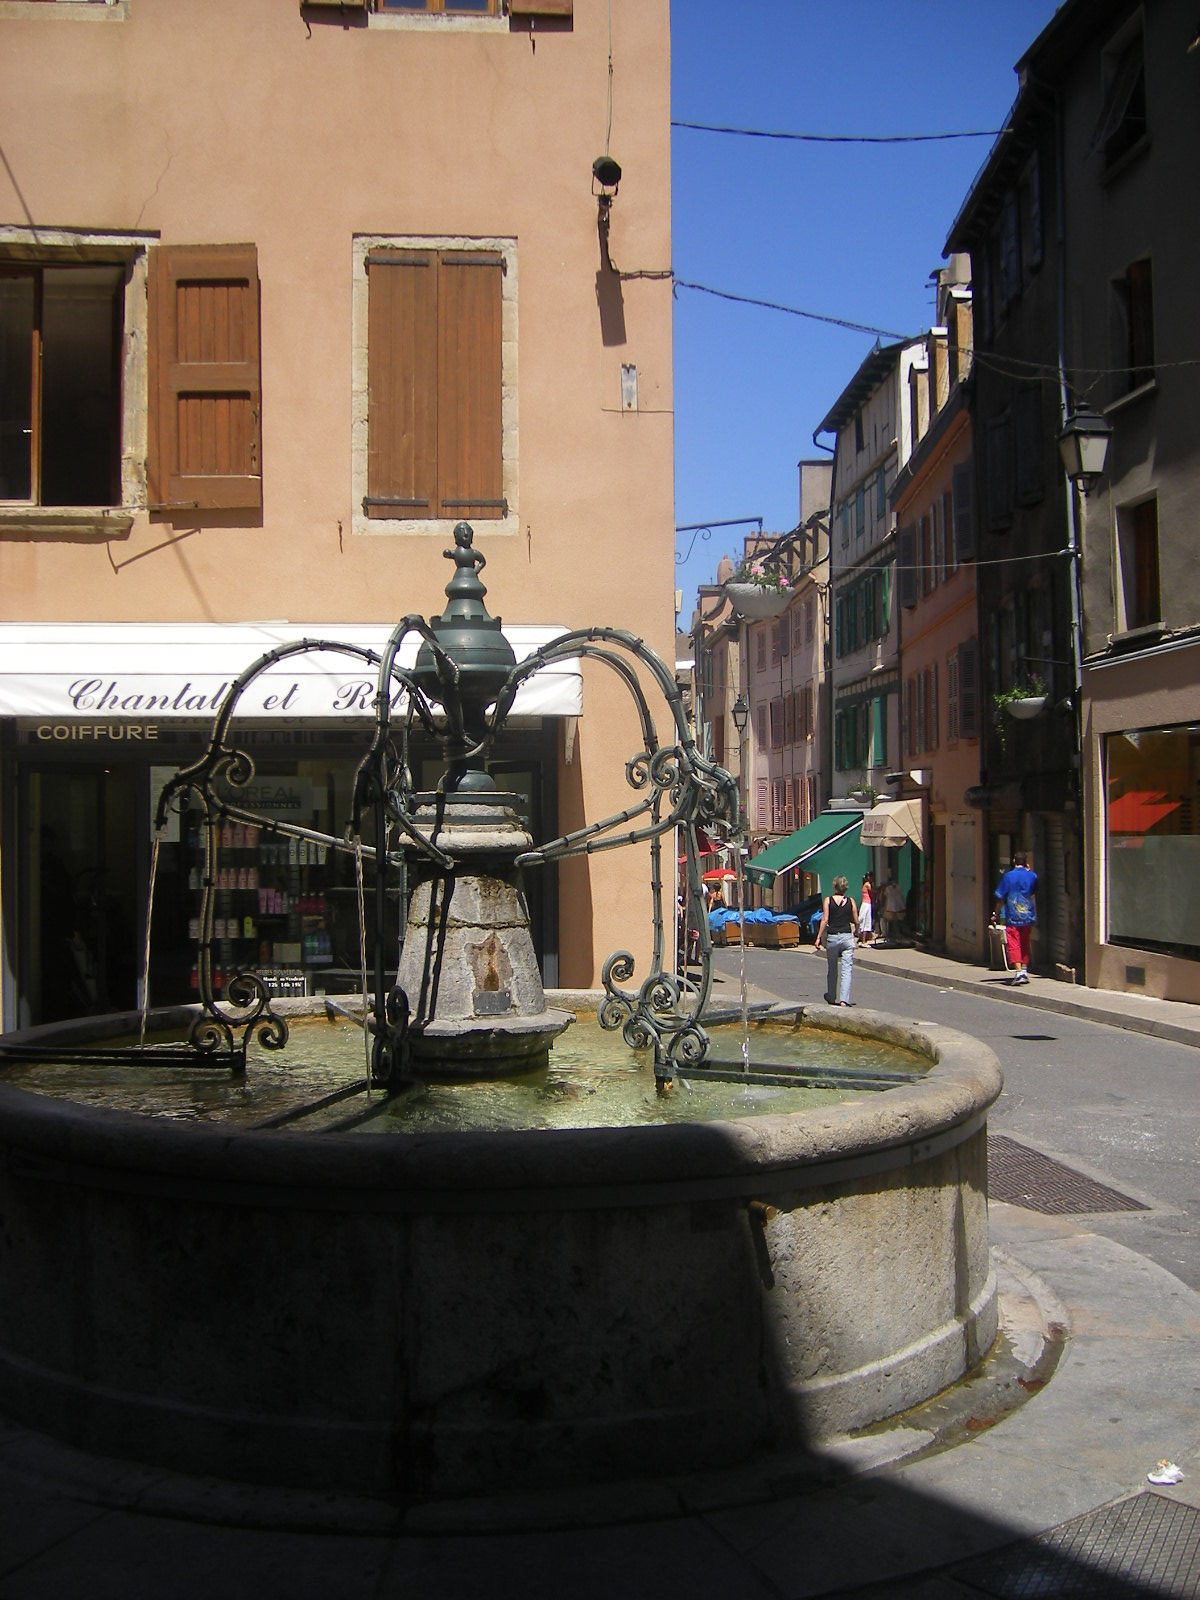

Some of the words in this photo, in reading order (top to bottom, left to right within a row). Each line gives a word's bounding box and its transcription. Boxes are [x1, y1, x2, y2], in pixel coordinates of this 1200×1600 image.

[68, 678, 230, 711] Chantal
[262, 682, 299, 711] et
[36, 725, 158, 740] COIFFURE
